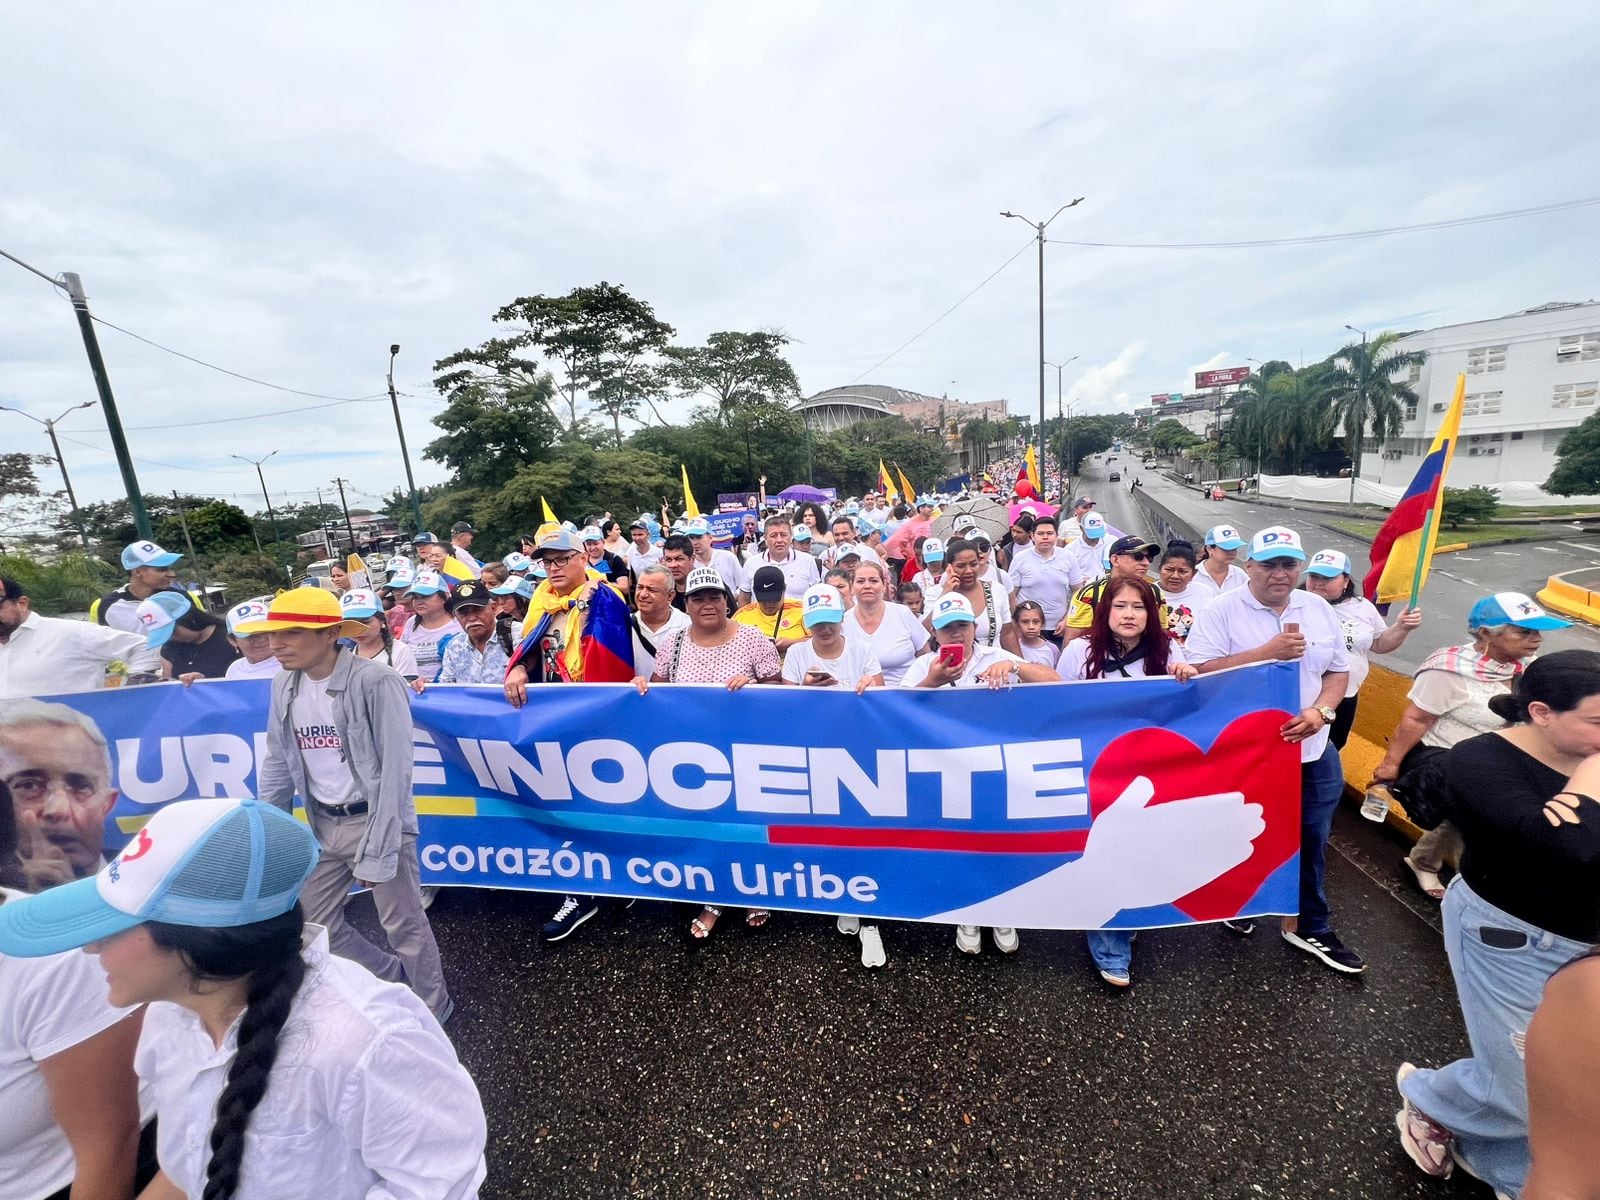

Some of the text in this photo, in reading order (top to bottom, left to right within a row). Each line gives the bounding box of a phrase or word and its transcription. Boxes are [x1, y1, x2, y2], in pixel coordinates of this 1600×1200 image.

[300, 736, 342, 749] INOCE
[456, 737, 1089, 820] INOCENTE
[421, 841, 880, 902] corazón con Uribe
